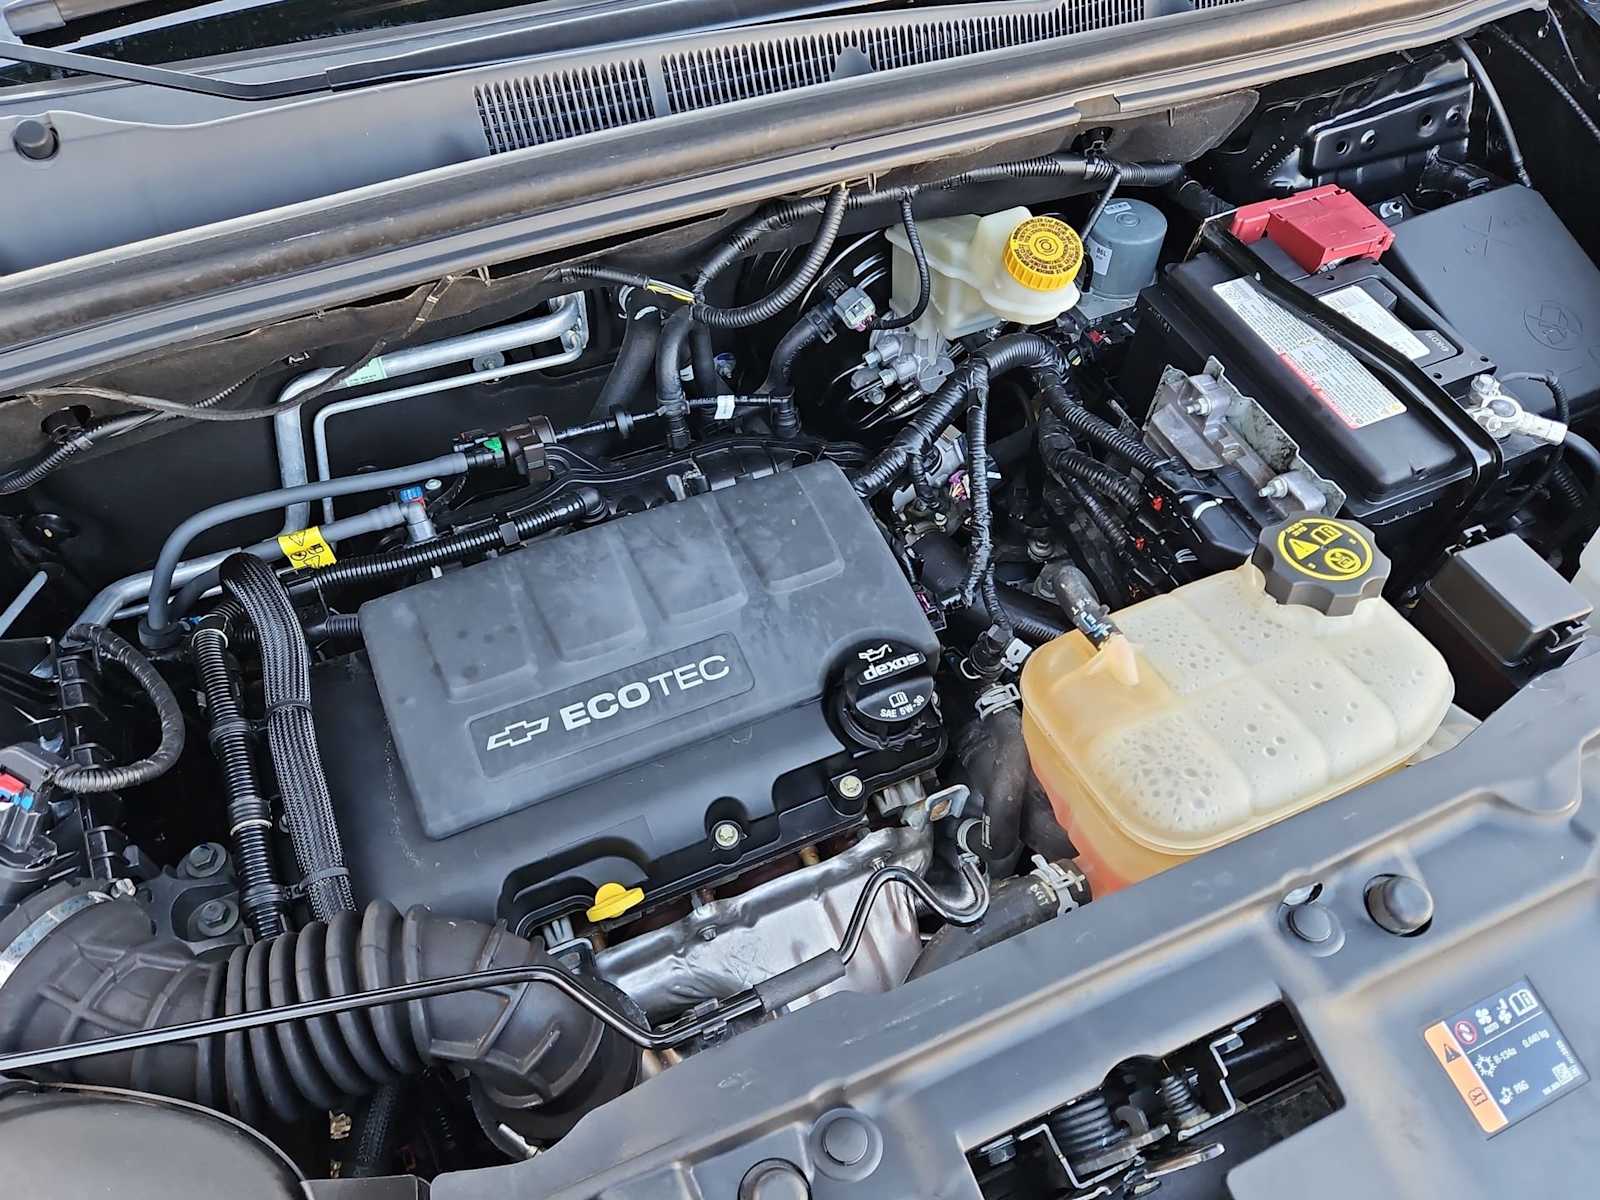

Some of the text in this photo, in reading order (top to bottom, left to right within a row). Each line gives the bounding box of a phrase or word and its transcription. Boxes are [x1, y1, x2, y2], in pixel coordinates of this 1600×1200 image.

[863, 653, 920, 680] dexos
[559, 655, 729, 731] ECOTEC
[880, 695, 925, 717] SAE 5W-30
